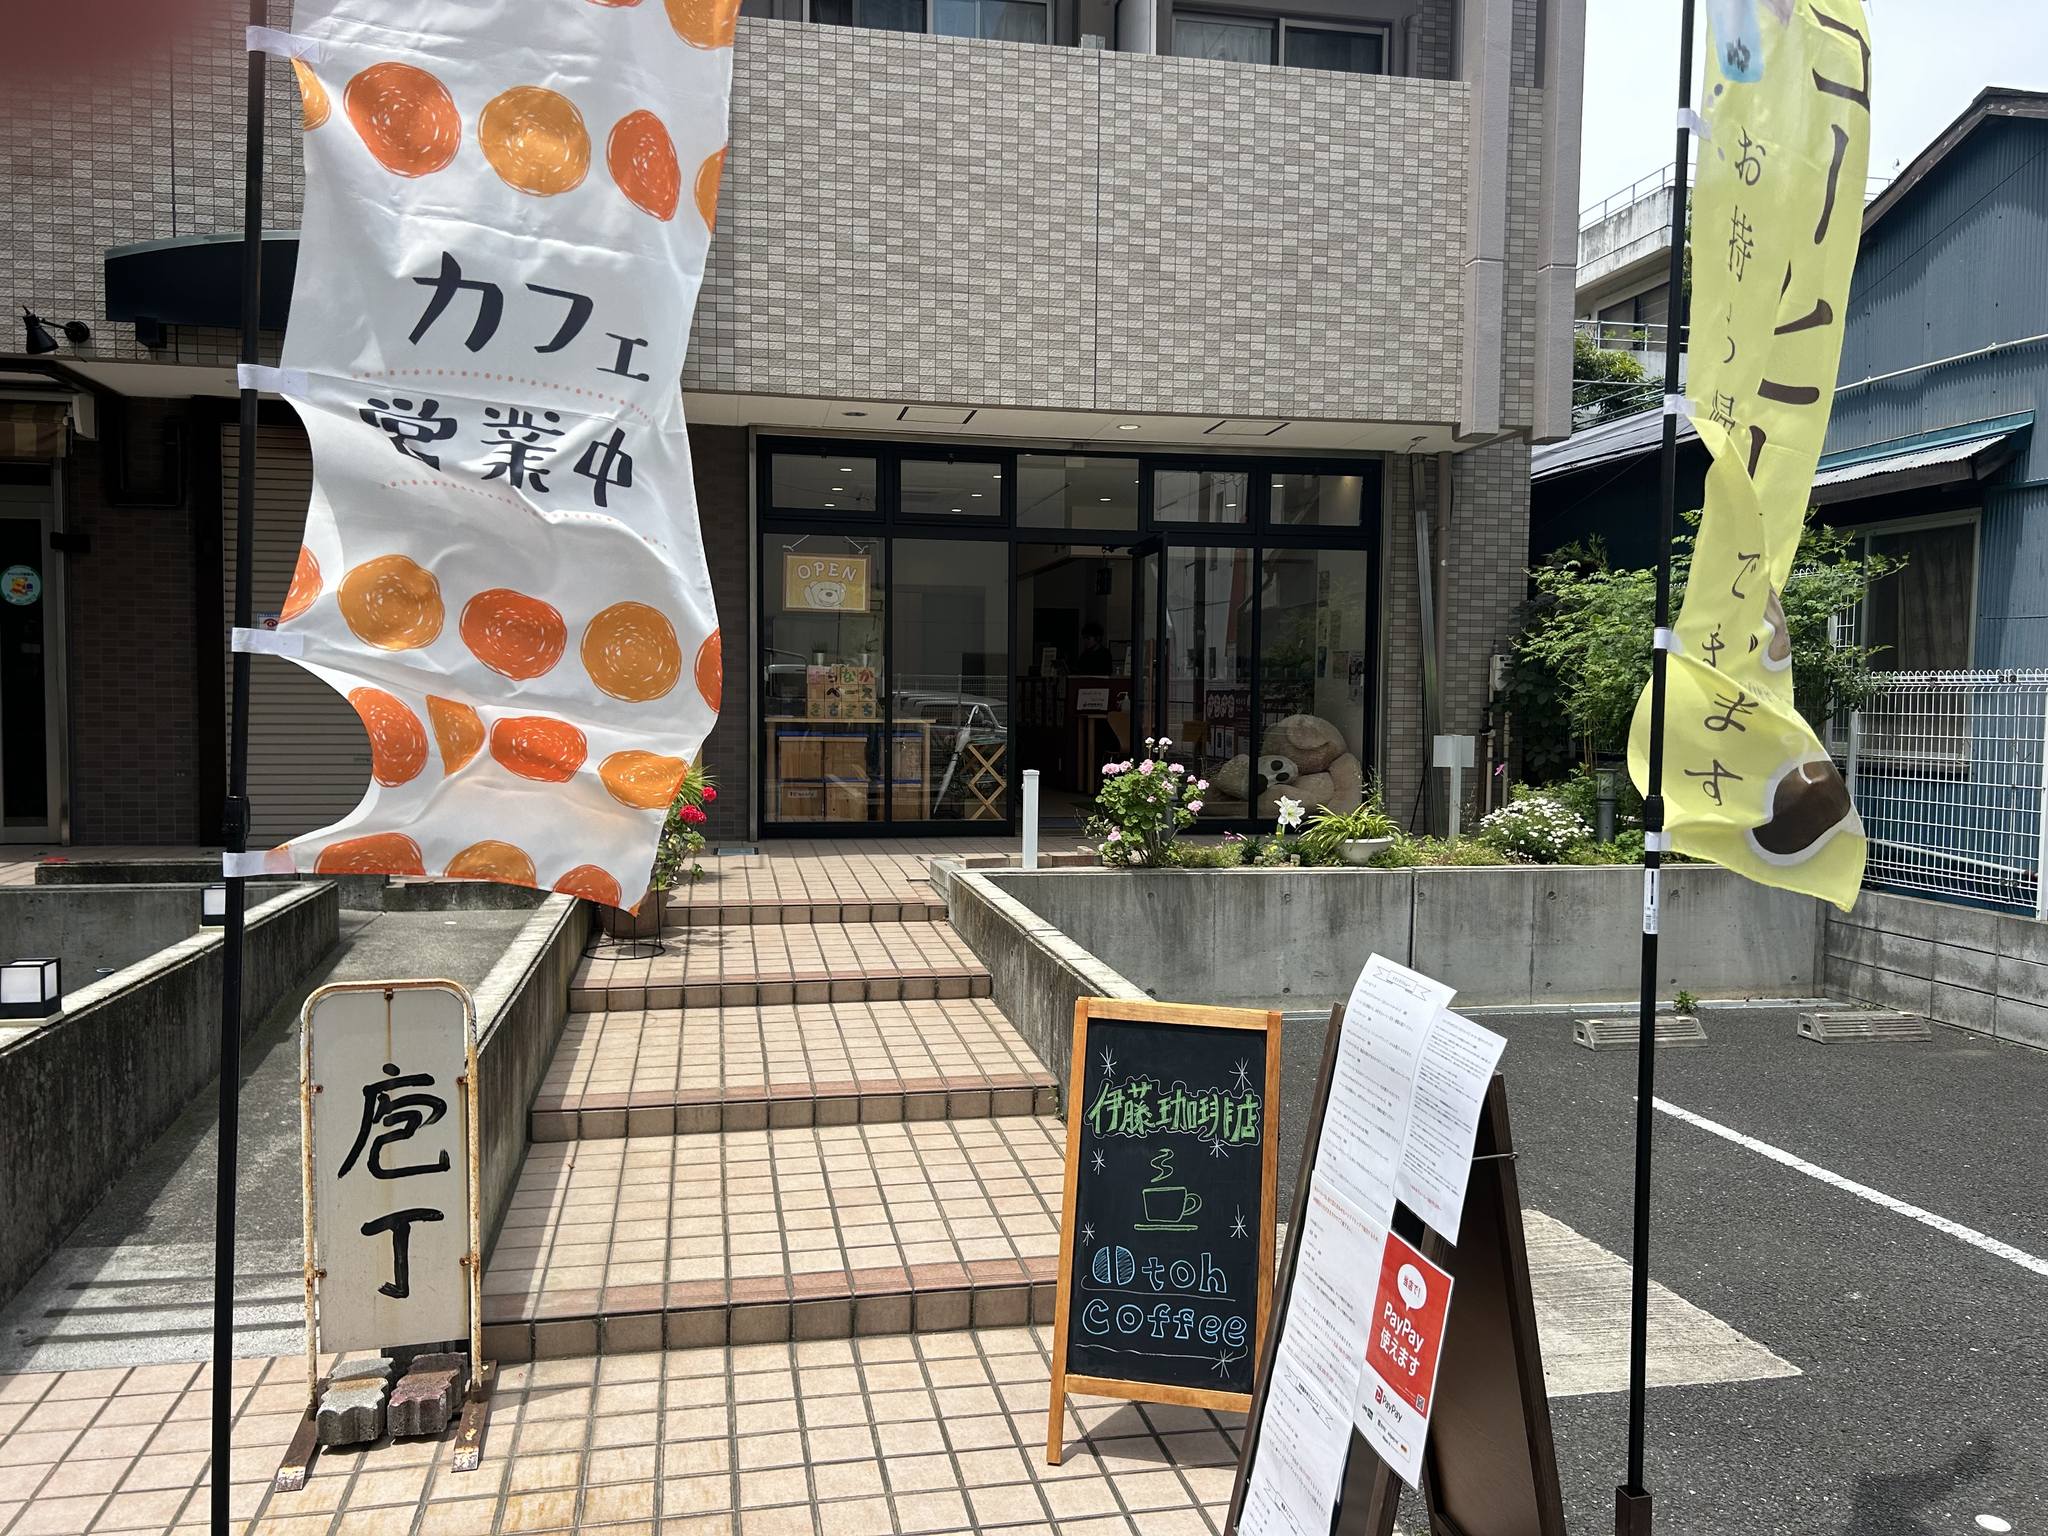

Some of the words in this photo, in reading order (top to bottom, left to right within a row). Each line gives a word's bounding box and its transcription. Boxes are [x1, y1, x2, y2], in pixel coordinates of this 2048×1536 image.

[407, 250, 651, 383] カフェ
[358, 397, 634, 508] 営業中
[798, 561, 857, 582] OPEN
[1087, 1081, 1260, 1143] 伊藤珈琲店
[1082, 1298, 1248, 1347] Coffee
[1383, 1301, 1425, 1352] PayPay
[1379, 1326, 1421, 1377] 使えます
[1382, 1391, 1403, 1423] PayPay
